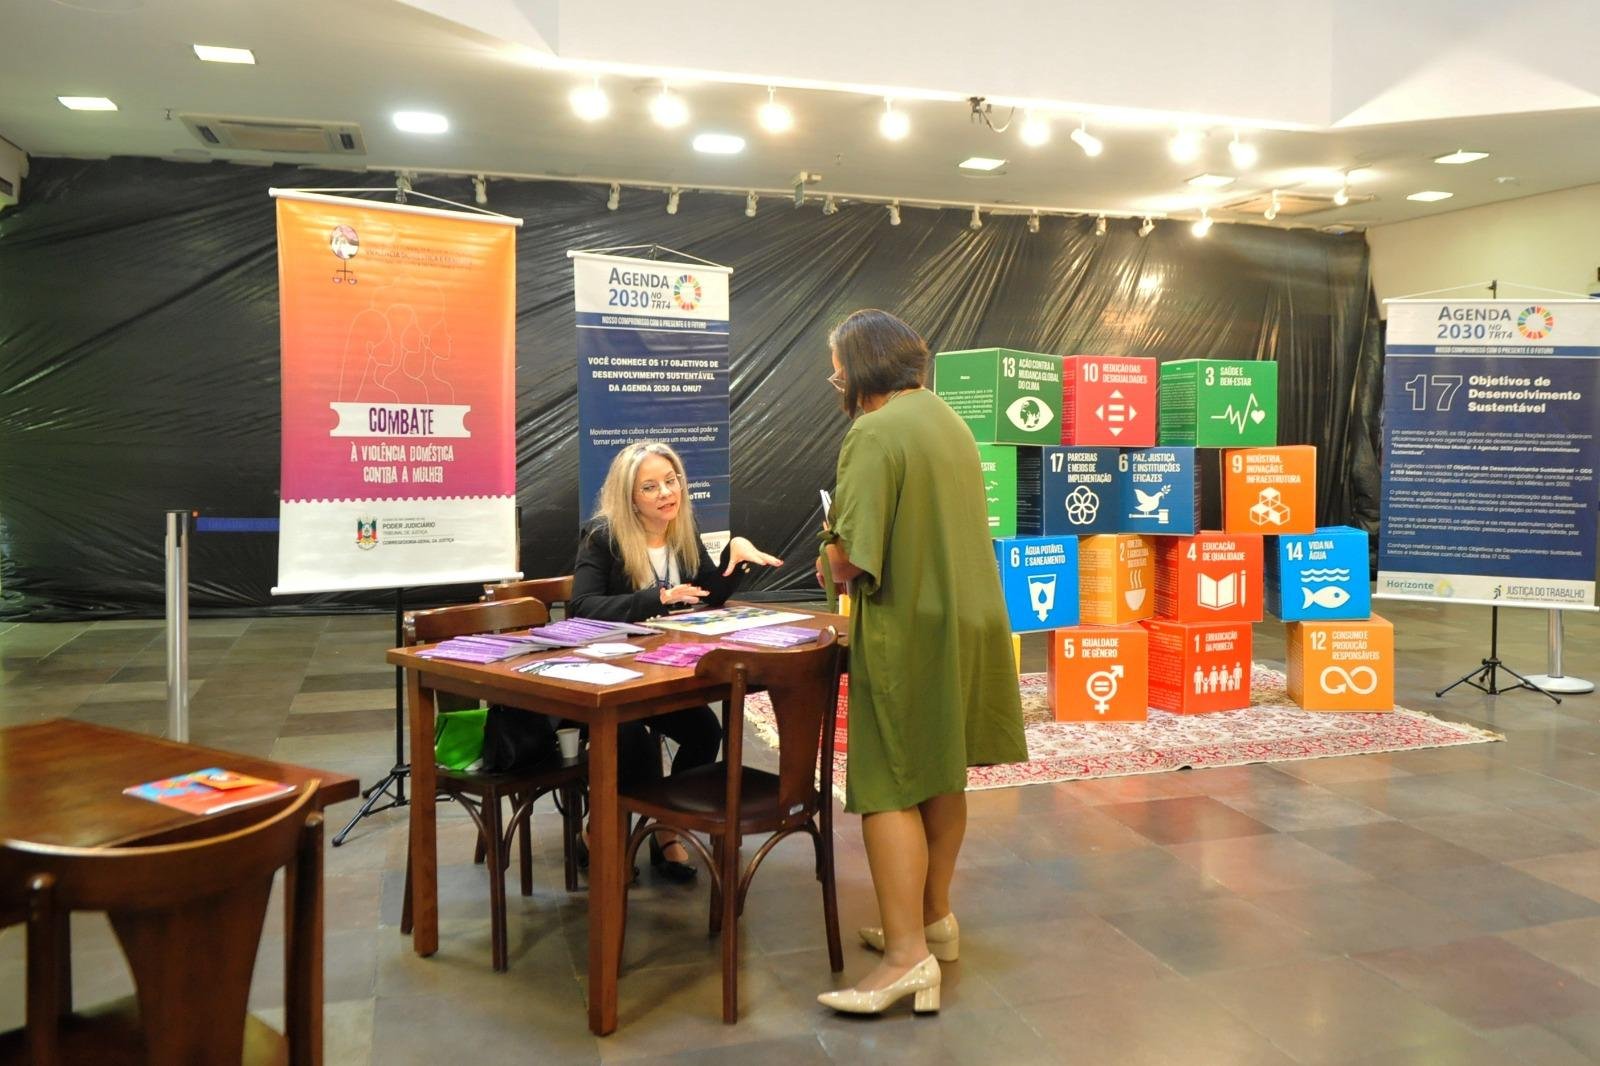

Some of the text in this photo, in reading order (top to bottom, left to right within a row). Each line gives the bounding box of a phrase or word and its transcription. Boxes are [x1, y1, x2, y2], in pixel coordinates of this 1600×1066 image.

[609, 267, 669, 289] AGENDA
[609, 289, 648, 308] 2030
[651, 300, 670, 309] TRT4
[1438, 307, 1511, 321] AGENDA
[1437, 324, 1485, 339] 2030
[588, 356, 609, 365] VOCÊ
[611, 358, 647, 366] CONHECE
[1019, 358, 1032, 368] AÇÃO
[1032, 360, 1050, 370] CONTRA
[1003, 357, 1015, 377] 13
[1083, 363, 1098, 382] 10
[1220, 366, 1238, 376] SAÚDE
[592, 370, 715, 380] DESENVOLVIMENTO SUSTENTÁVEL
[1206, 366, 1215, 386] 3
[1018, 380, 1040, 390] DO CLIMA
[1220, 377, 1251, 386] BEM-ESTAR
[1469, 376, 1551, 387] Objetivos de
[622, 384, 651, 392] AGENDA
[1405, 374, 1463, 411] 17
[1468, 389, 1581, 400] Desenvolvimento
[1468, 402, 1546, 413] Sustentável
[369, 408, 434, 435] COMBATE
[351, 442, 453, 462] À VIOLÊNCIA DOMÉSTICA
[1068, 453, 1097, 461] PARCERIAS
[1148, 453, 1175, 462] JUSTIÇA
[1050, 453, 1064, 472] 17
[1072, 464, 1088, 472] MEIOS
[1089, 464, 1096, 472] DE
[1137, 463, 1180, 473] INSTITUIÇÕES
[1232, 455, 1243, 473] 9
[364, 466, 443, 483] CONTRA A MULHER
[1246, 464, 1279, 474] INOVAÇÃO
[1068, 473, 1111, 483] IMPLEMENTAÇÃO
[1133, 474, 1162, 482] EFICAZES
[1025, 544, 1064, 556] ÁGUA POTÁVEL
[1202, 541, 1235, 551] EDUCAÇÃO
[1309, 541, 1334, 550] VIDA NA
[1010, 547, 1020, 567] 6
[1187, 543, 1197, 561] 4
[1203, 552, 1245, 561] DE QUALIDADE
[1286, 542, 1303, 561] 14
[1309, 551, 1327, 560] ÁGUA
[1029, 555, 1065, 566] SANEAMENTO
[1387, 579, 1434, 590] Horizonte
[1506, 585, 1584, 598] JUSTIÇA DO TRABALHO
[1311, 631, 1327, 650] 12
[1332, 631, 1364, 639] CONSUMO
[1064, 638, 1074, 658] 5
[1082, 638, 1119, 647] IGUALDADE
[1194, 634, 1200, 653] 1
[1332, 640, 1367, 650] PRODUÇÃO
[1092, 649, 1117, 658] GÊNERO
